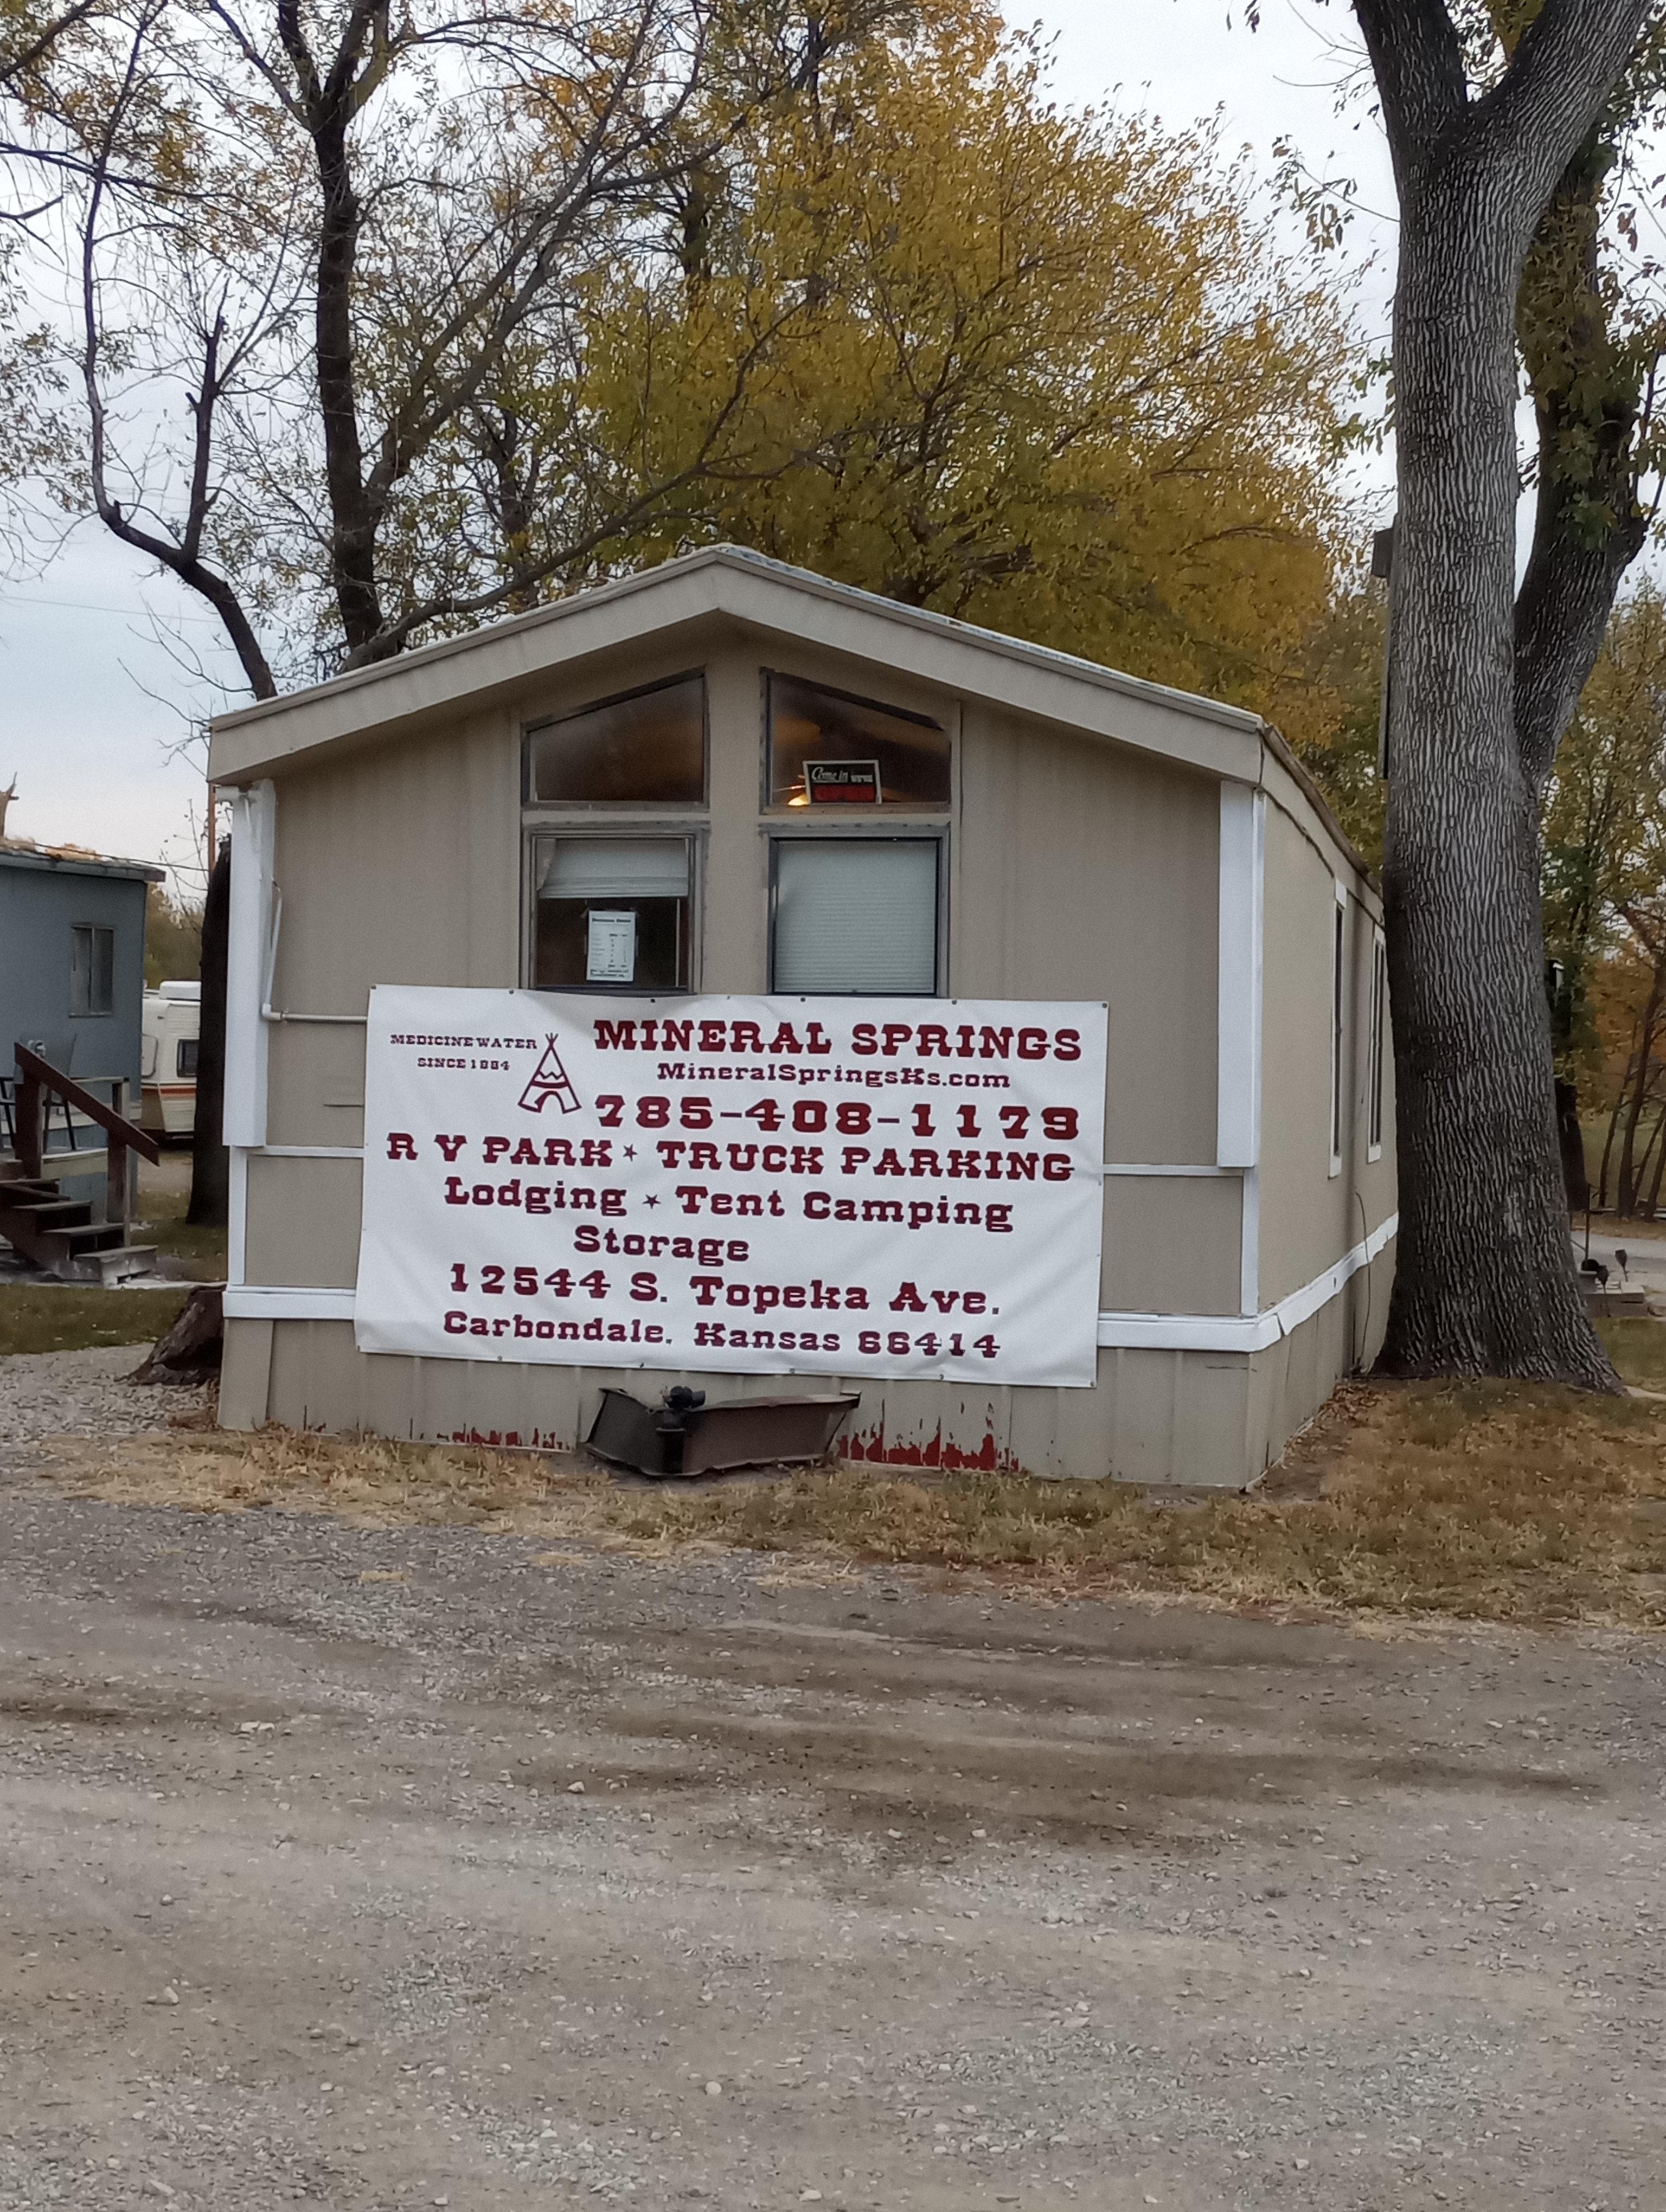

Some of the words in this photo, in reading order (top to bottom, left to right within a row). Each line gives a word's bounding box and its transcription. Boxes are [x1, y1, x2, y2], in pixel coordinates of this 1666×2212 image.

[390, 1034, 475, 1047] MEDICINE
[476, 1037, 537, 1050] WATER
[592, 1019, 832, 1054] MINERAL
[851, 1023, 1081, 1062] SPRINGS
[417, 1057, 466, 1069] SINCE
[657, 1062, 1011, 1088] MineralSpringsKs.com
[594, 1095, 1079, 1141] 785-408-1179
[482, 1136, 613, 1167] PARK
[656, 1140, 824, 1175] TRUCK
[840, 1146, 1075, 1181] PARKING
[444, 1176, 627, 1217] Lodging
[674, 1185, 785, 1217] Tent
[803, 1191, 1014, 1233] Camping
[573, 1224, 749, 1267] Storage
[450, 1263, 611, 1299] 12544
[629, 1271, 668, 1303] S.
[689, 1276, 870, 1315] Topeka
[888, 1281, 999, 1315] Ave.
[694, 1322, 841, 1352] Kansas
[858, 1330, 1001, 1359] 66414
